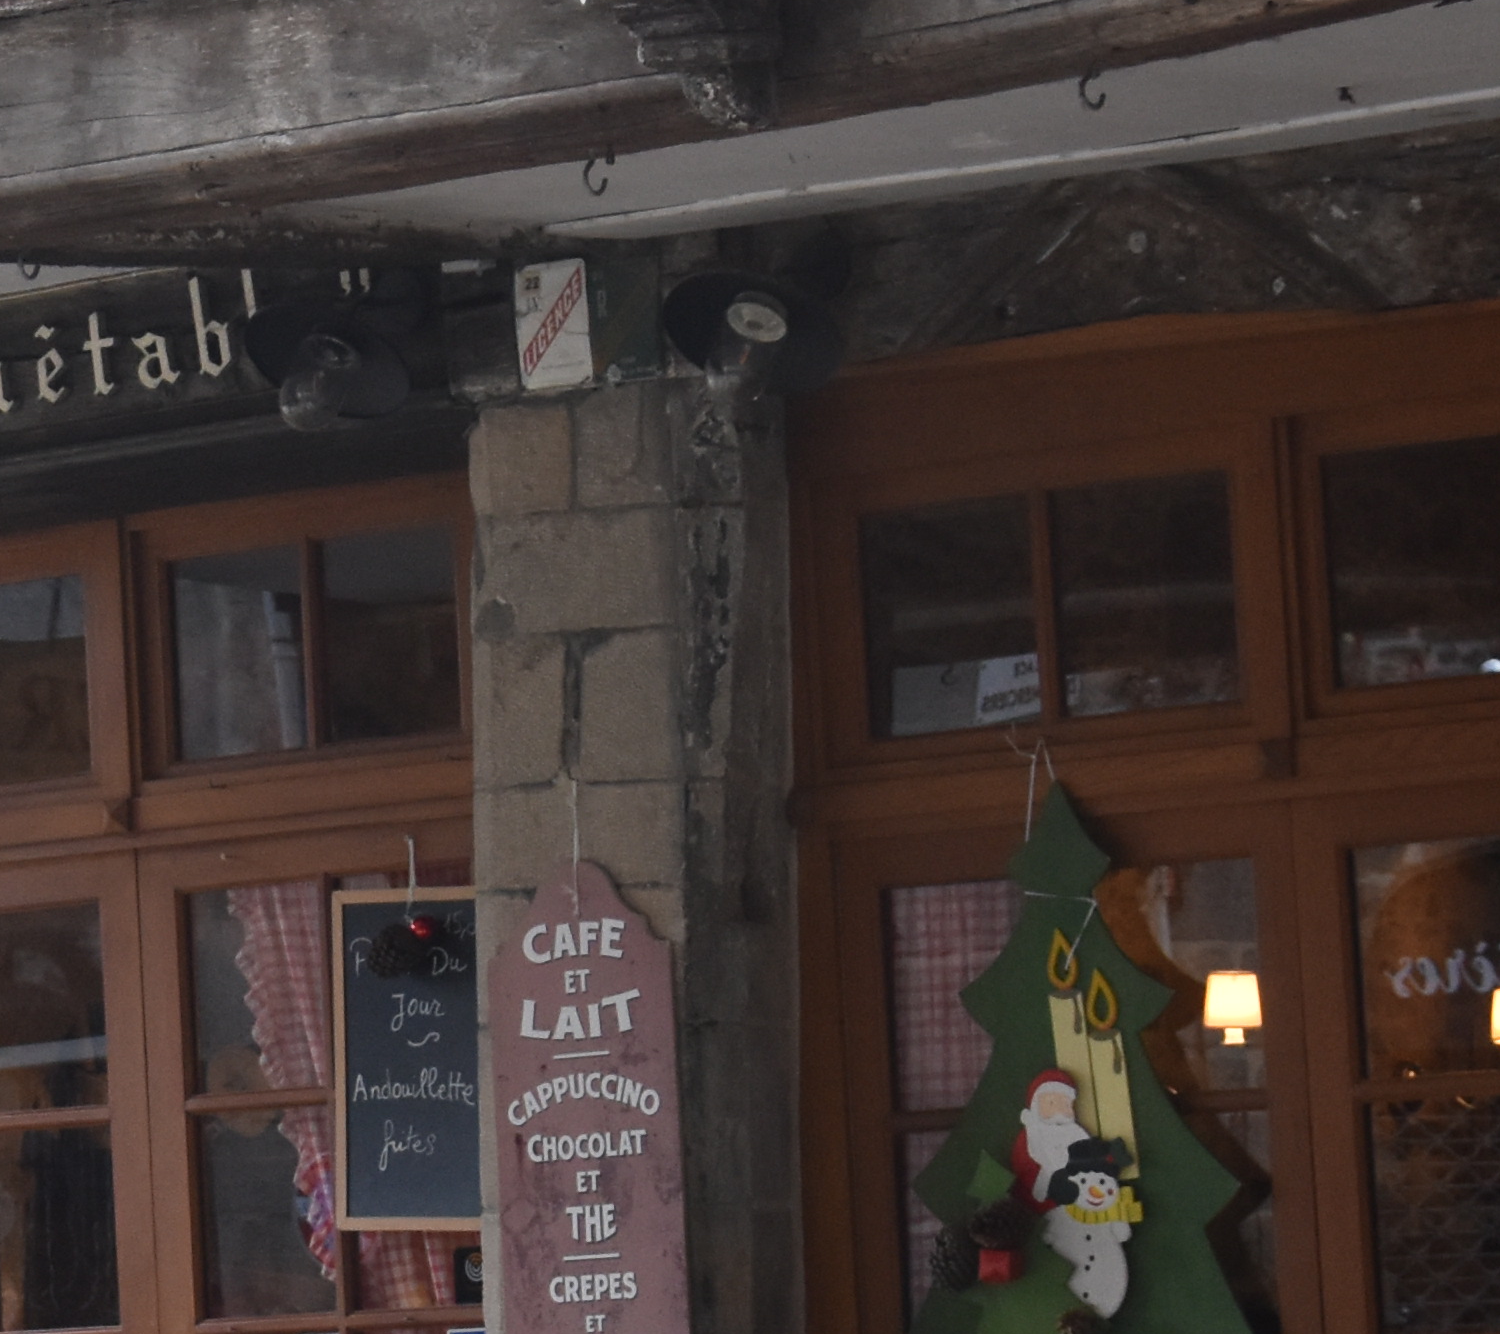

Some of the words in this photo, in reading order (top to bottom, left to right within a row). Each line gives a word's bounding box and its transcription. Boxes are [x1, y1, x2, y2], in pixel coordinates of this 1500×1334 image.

[524, 267, 581, 374] LICENCE
[522, 917, 626, 964] CAFE
[563, 968, 591, 994] ET
[391, 993, 446, 1032] Jour
[520, 988, 641, 1040] LAIT
[352, 1067, 476, 1106] Andouillette
[507, 1072, 660, 1126] CAPPUCCINO
[527, 1129, 647, 1163] CHOCOLAT
[576, 1170, 601, 1193] ET
[566, 1203, 617, 1243] THE
[550, 1272, 638, 1303] CREPES
[585, 1314, 606, 1333] ET
